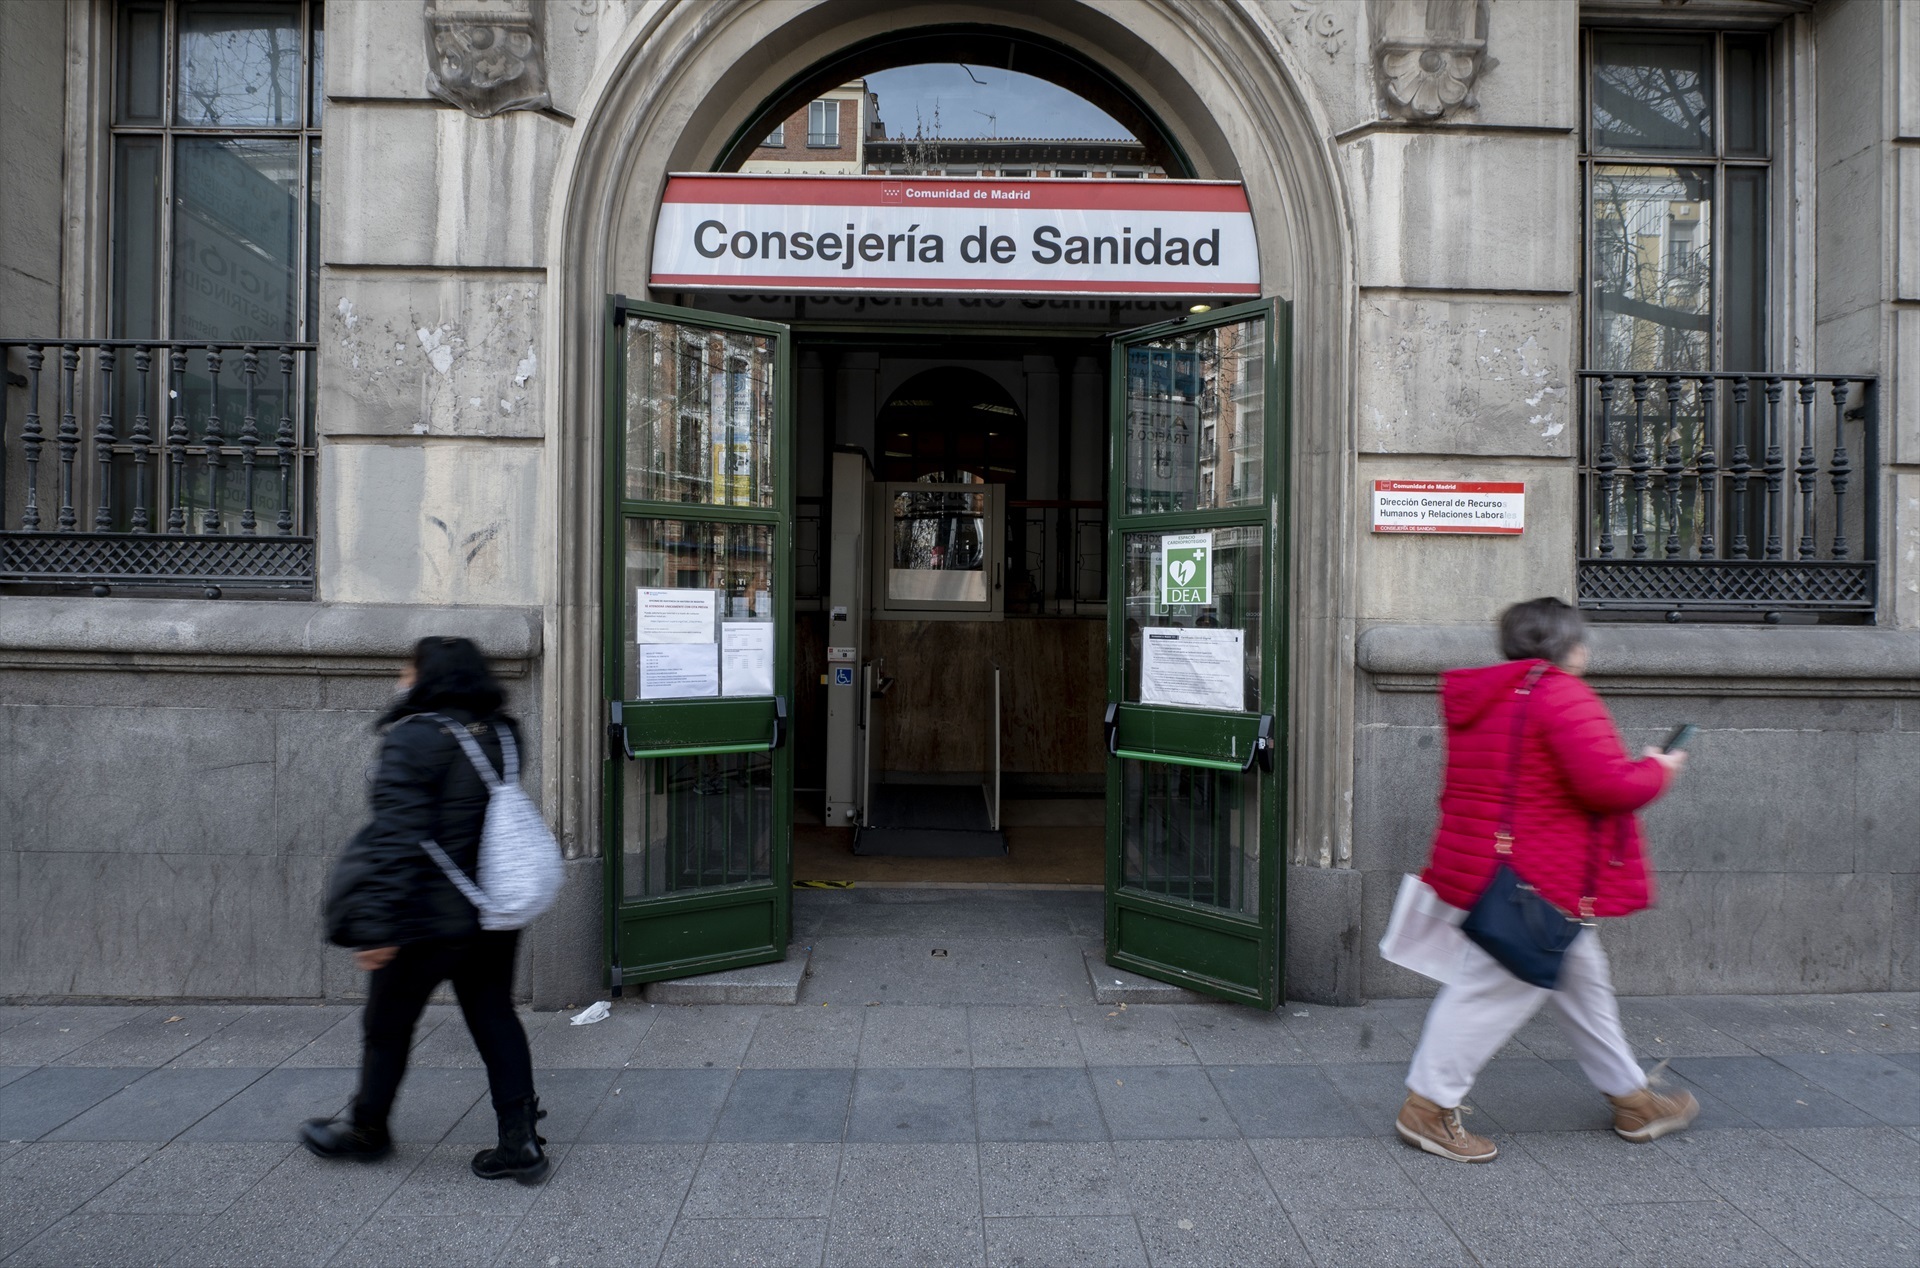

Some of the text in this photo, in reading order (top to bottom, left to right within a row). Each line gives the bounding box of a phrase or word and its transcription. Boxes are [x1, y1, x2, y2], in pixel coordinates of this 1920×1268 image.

[905, 188, 1031, 201] Comunidad de Madrid
[693, 219, 1220, 269] Consejería de Sanidad
[1380, 498, 1419, 507] Dirección
[1421, 498, 1453, 508] General
[1455, 499, 1465, 508] de
[1380, 510, 1418, 518] Humanos
[1421, 512, 1426, 520] y
[1428, 510, 1473, 519] Relaciones
[1172, 589, 1201, 602] DEA
